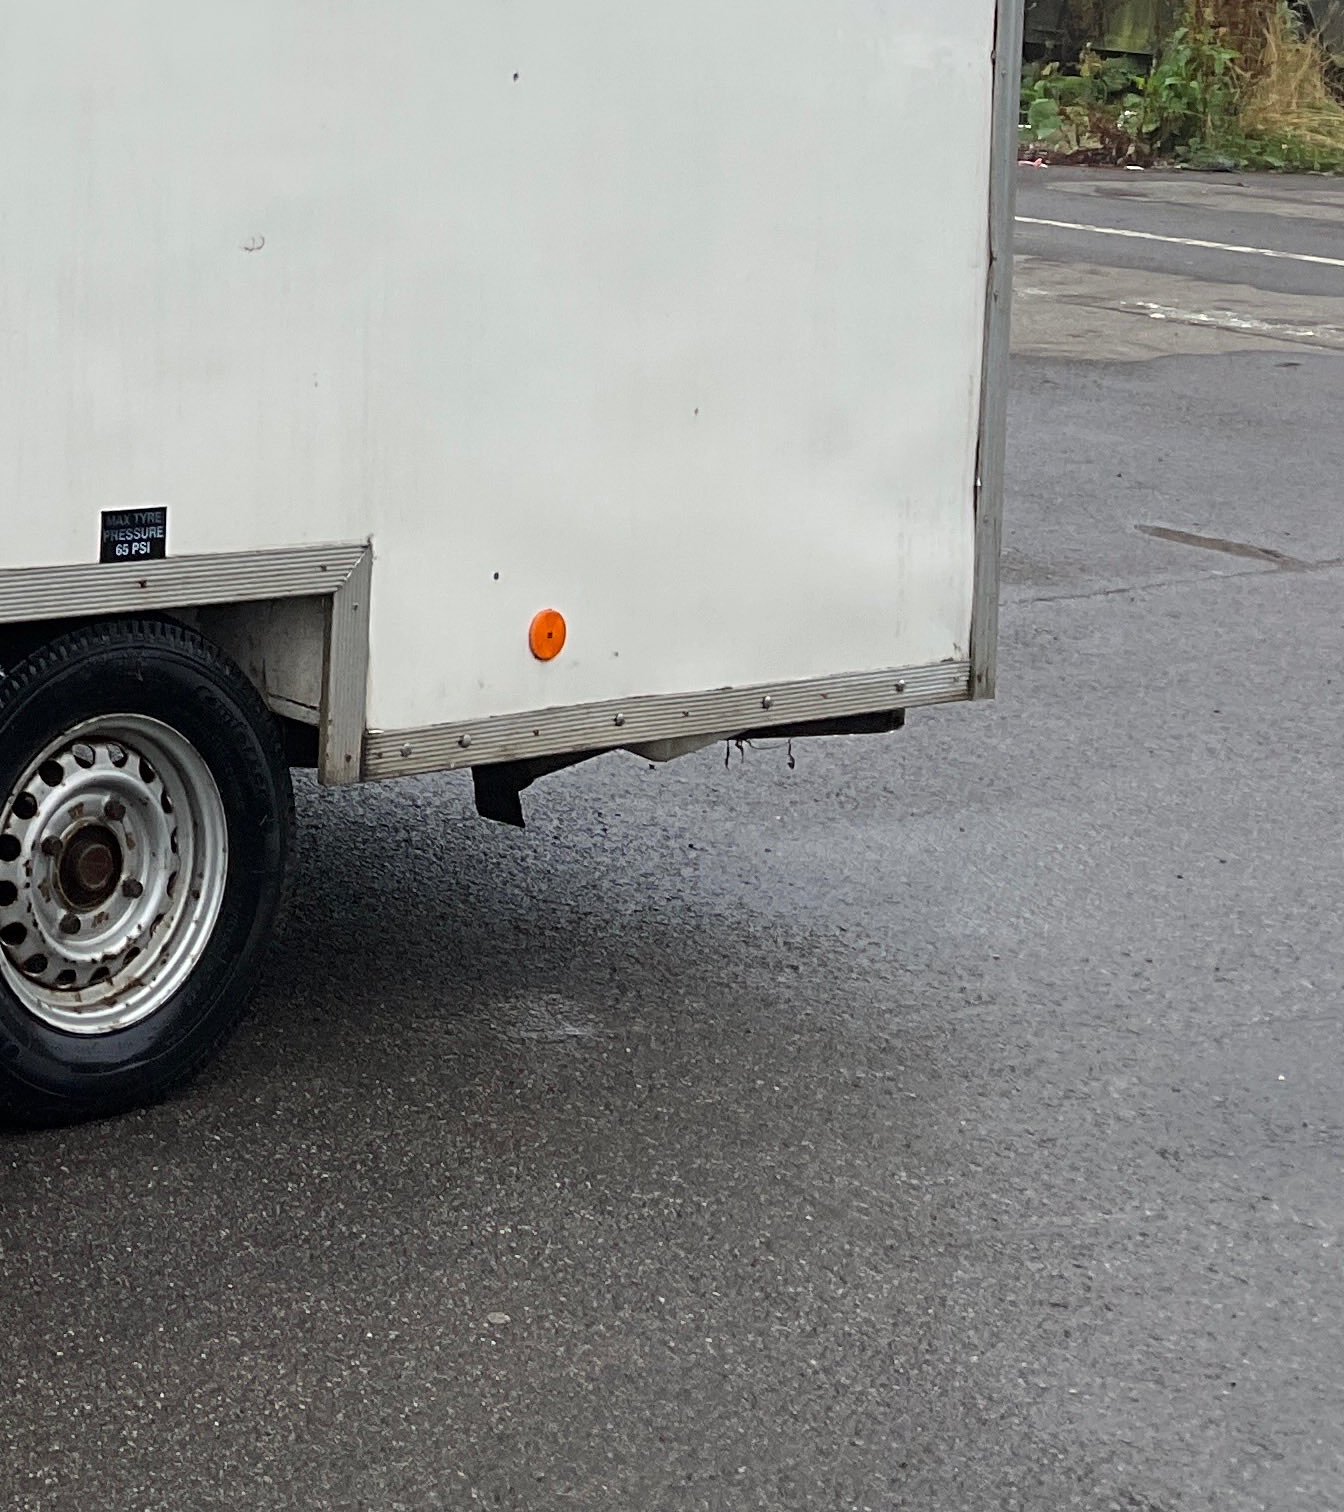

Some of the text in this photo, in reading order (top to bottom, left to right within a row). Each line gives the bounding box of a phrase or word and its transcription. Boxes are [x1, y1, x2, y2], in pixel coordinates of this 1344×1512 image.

[106, 511, 162, 526] MAX TYRE
[103, 525, 164, 543] PRESSURE
[115, 541, 150, 556] 65 PSI
